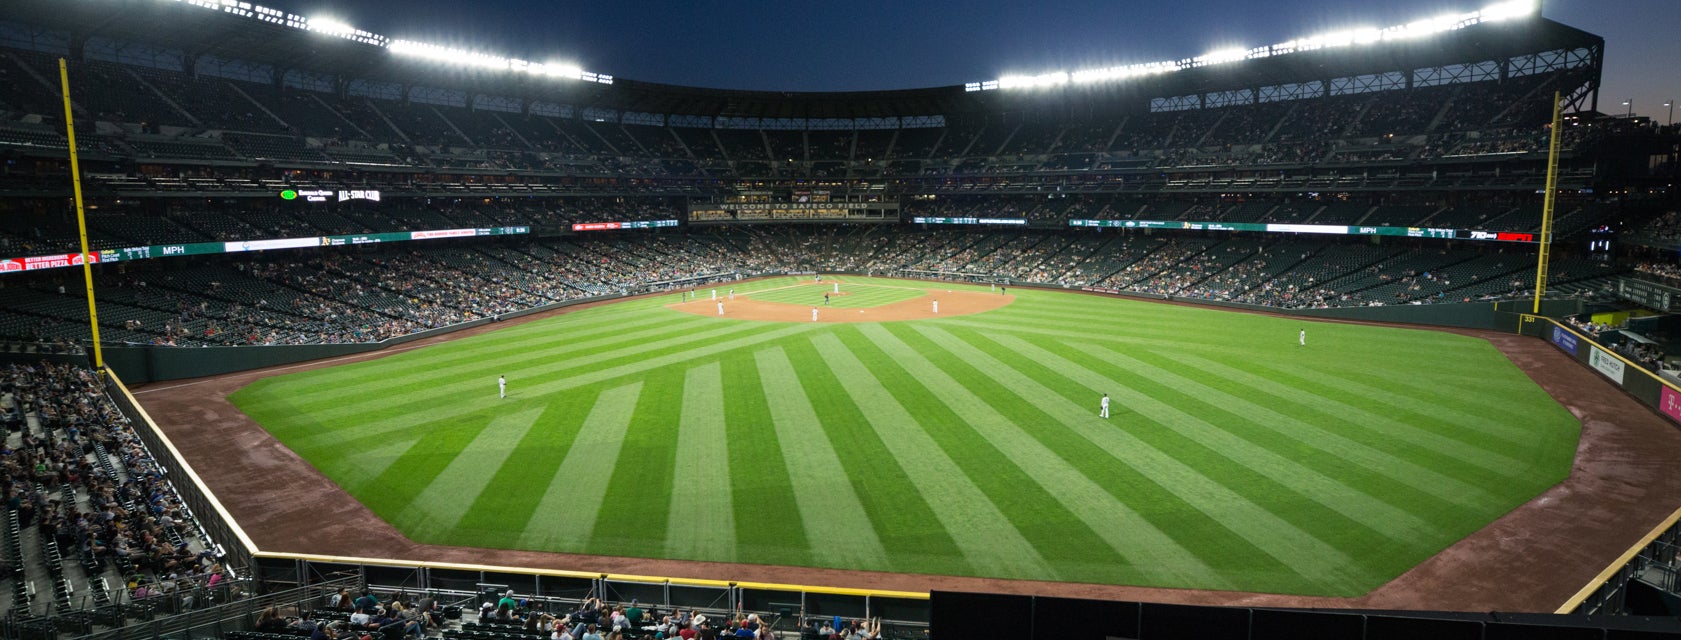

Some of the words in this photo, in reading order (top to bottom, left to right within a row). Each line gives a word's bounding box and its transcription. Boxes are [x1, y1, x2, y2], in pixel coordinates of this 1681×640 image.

[1498, 232, 1532, 242] ESPN
[163, 246, 185, 255] MPH
[26, 260, 50, 270] BETTER
[1668, 394, 1675, 411] T
